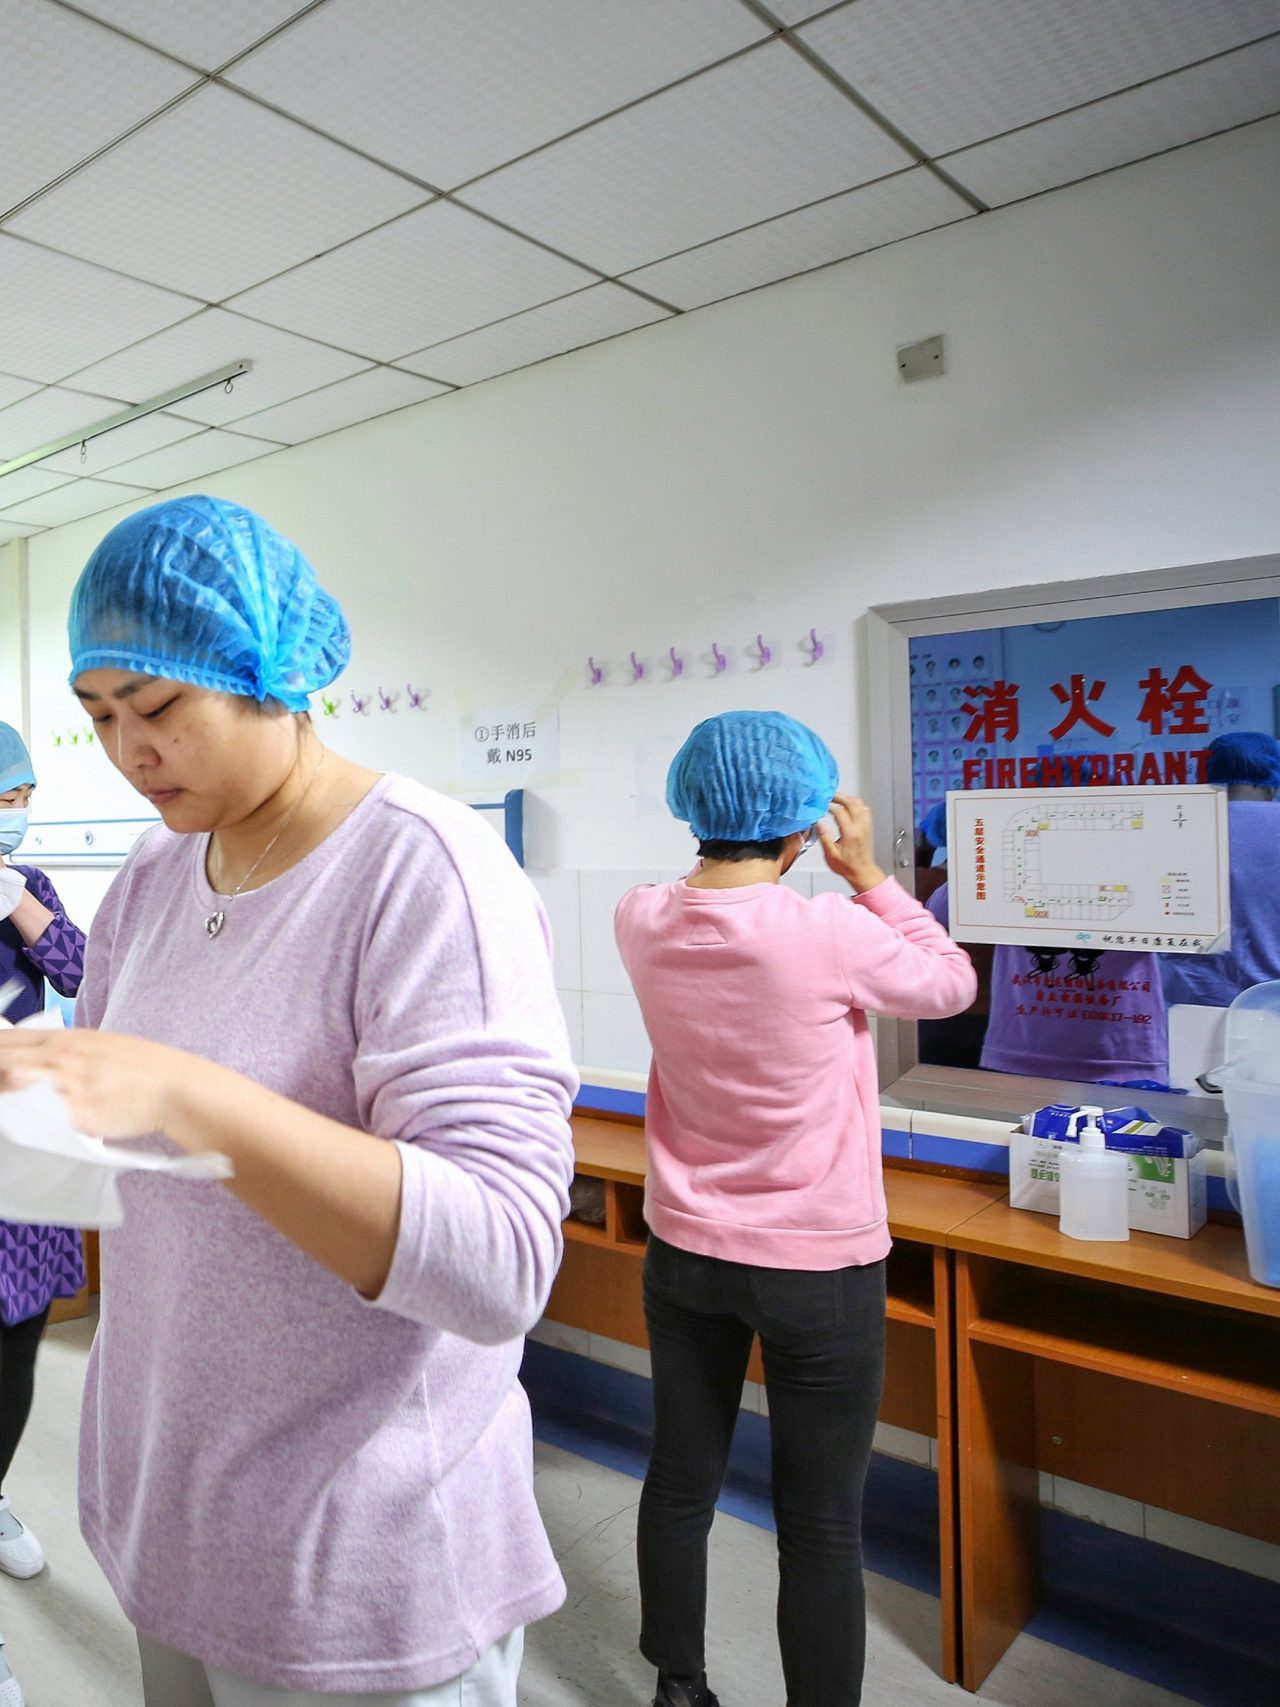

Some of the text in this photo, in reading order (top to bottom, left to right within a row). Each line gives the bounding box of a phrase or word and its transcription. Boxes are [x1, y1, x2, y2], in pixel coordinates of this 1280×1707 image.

[959, 664, 1213, 743] 消火栓
[506, 748, 533, 762] N95
